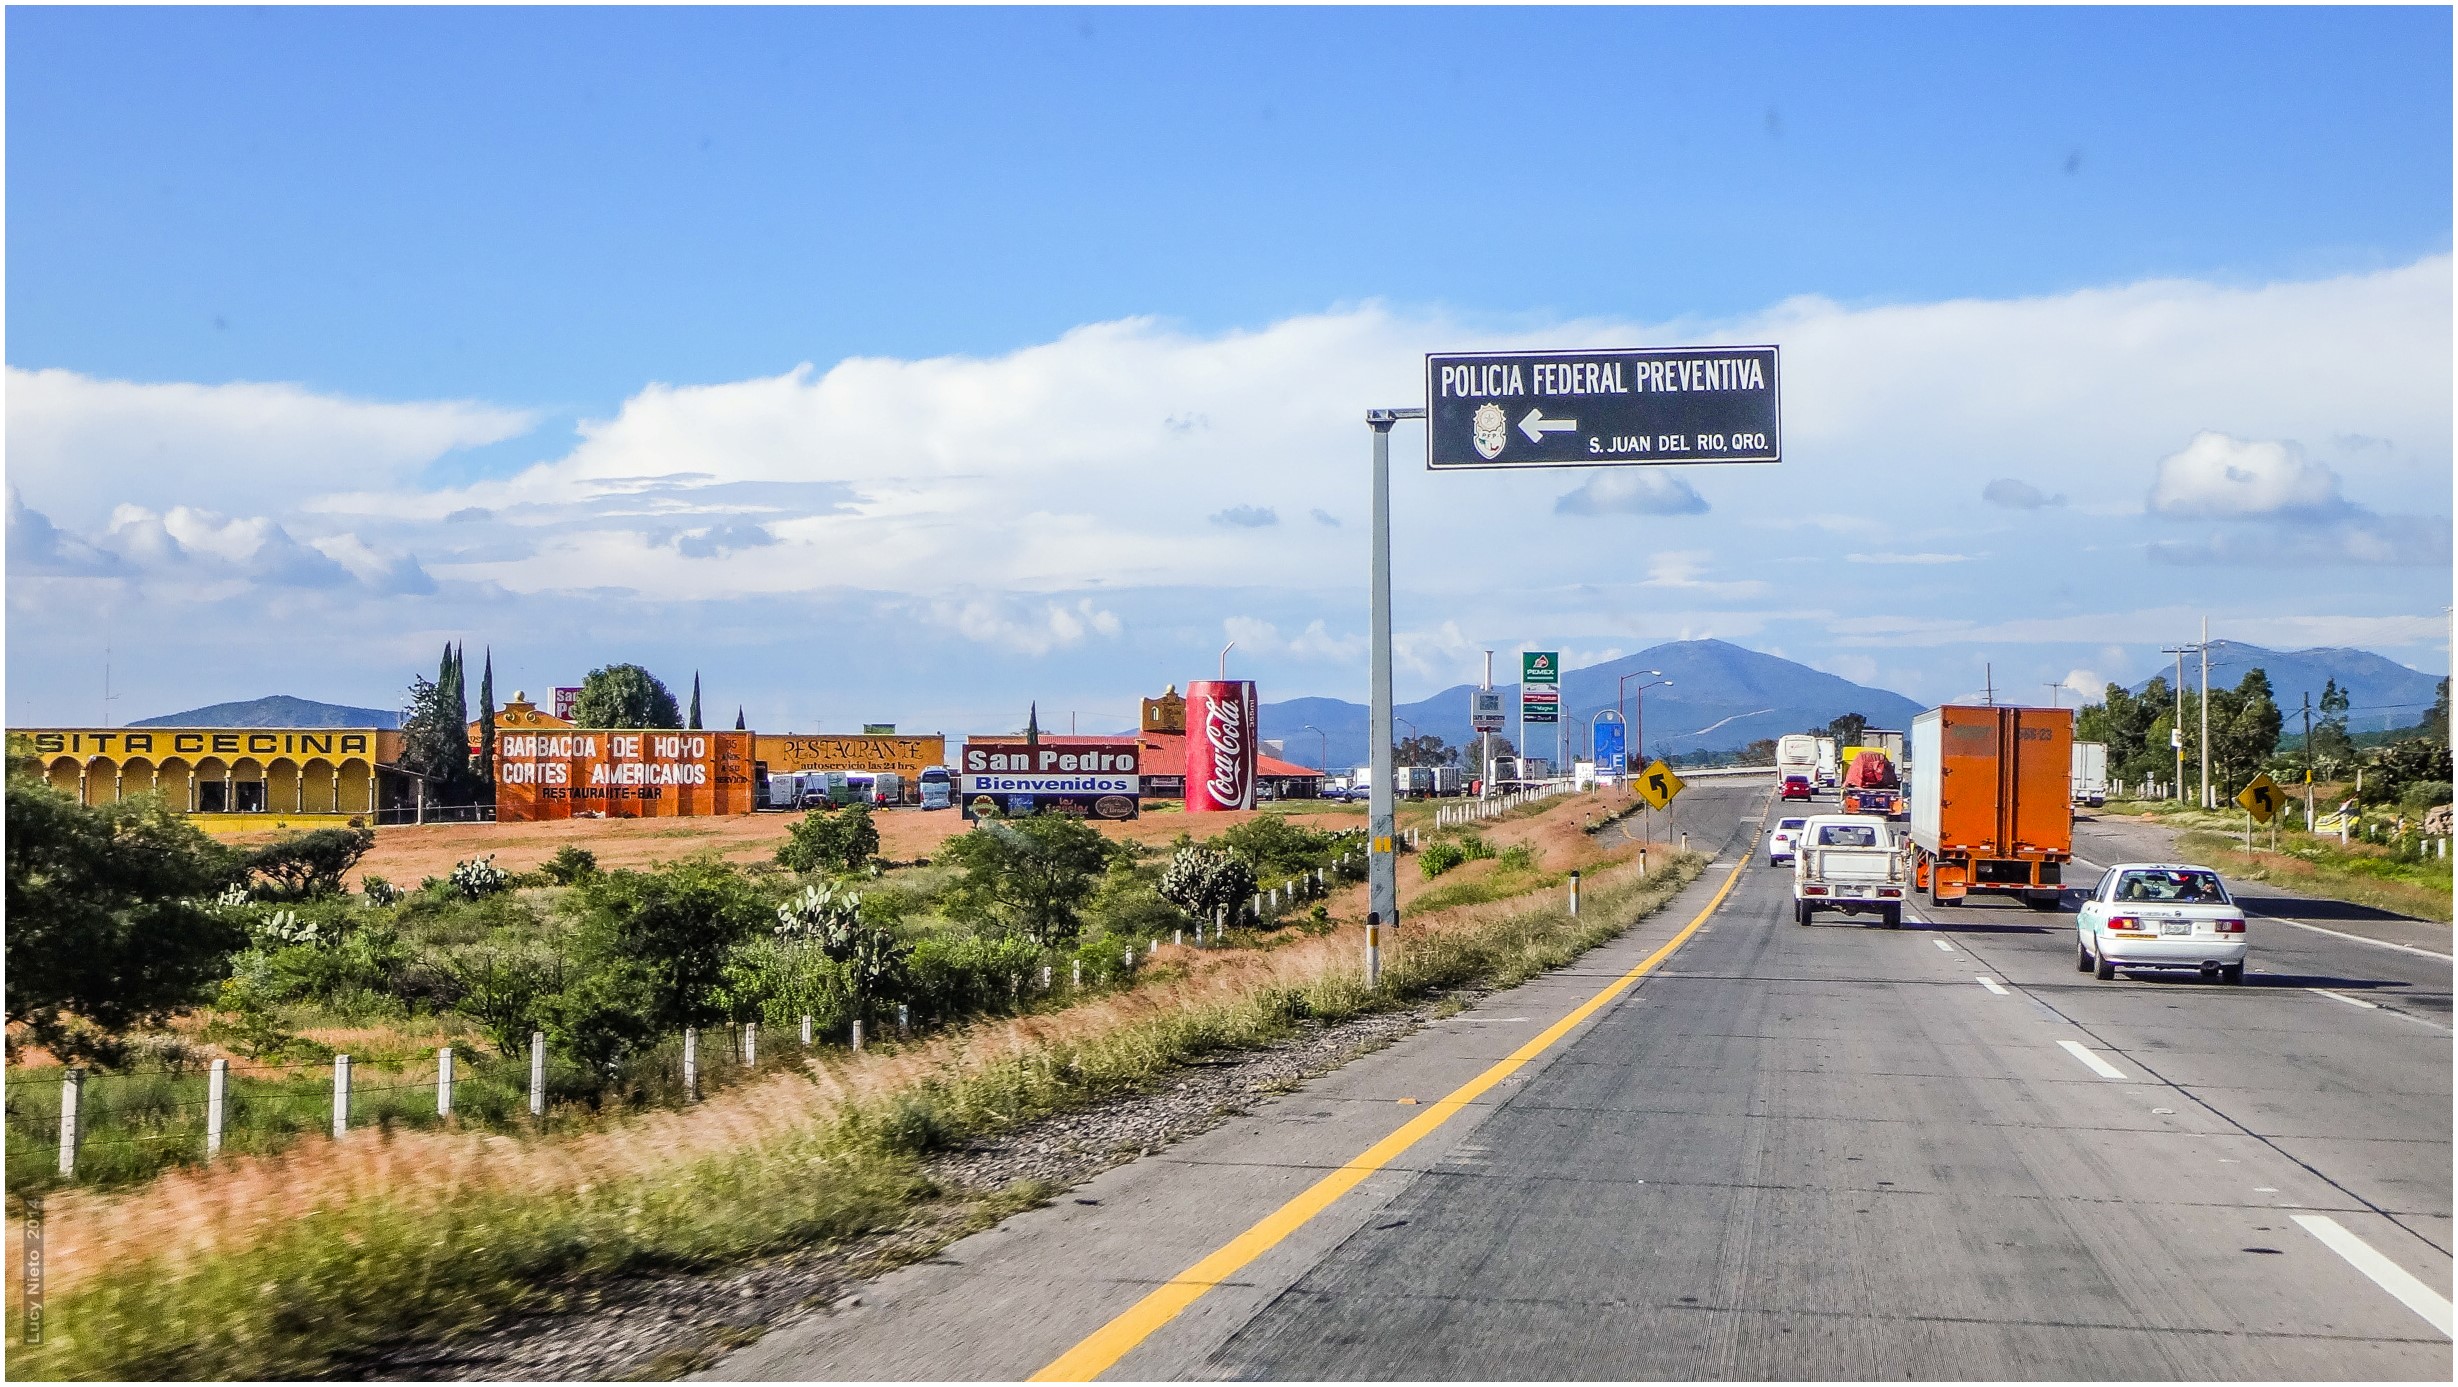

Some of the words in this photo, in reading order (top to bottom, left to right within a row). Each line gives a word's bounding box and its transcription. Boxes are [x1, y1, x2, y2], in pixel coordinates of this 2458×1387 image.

[1441, 364, 1525, 397] POLICIA
[1533, 362, 1628, 395] FEDERAL
[1636, 358, 1765, 393] PREVENTIVA
[1589, 436, 1604, 453] S.
[1606, 435, 1651, 453] JUAN
[1658, 434, 1691, 451] DEL
[1697, 433, 1728, 453] RIO,
[1731, 433, 1769, 451] QRO.
[20, 733, 153, 753] SITA
[174, 734, 367, 753] CECINA
[503, 736, 597, 758] BARBACOA
[613, 736, 639, 758] DE
[654, 736, 706, 758] HOYO
[783, 739, 924, 765] RESTAURANTE
[1205, 694, 1241, 807] Coca-Cola
[800, 760, 866, 771] autoservicio
[868, 760, 882, 771] las
[883, 760, 896, 771] 24
[897, 760, 918, 771] hrs.
[967, 750, 1030, 771] San
[1038, 750, 1134, 771] Pedro
[502, 762, 568, 784] CORTES
[591, 763, 706, 785] AMERICANOS
[975, 776, 1128, 791] Bienvenidos
